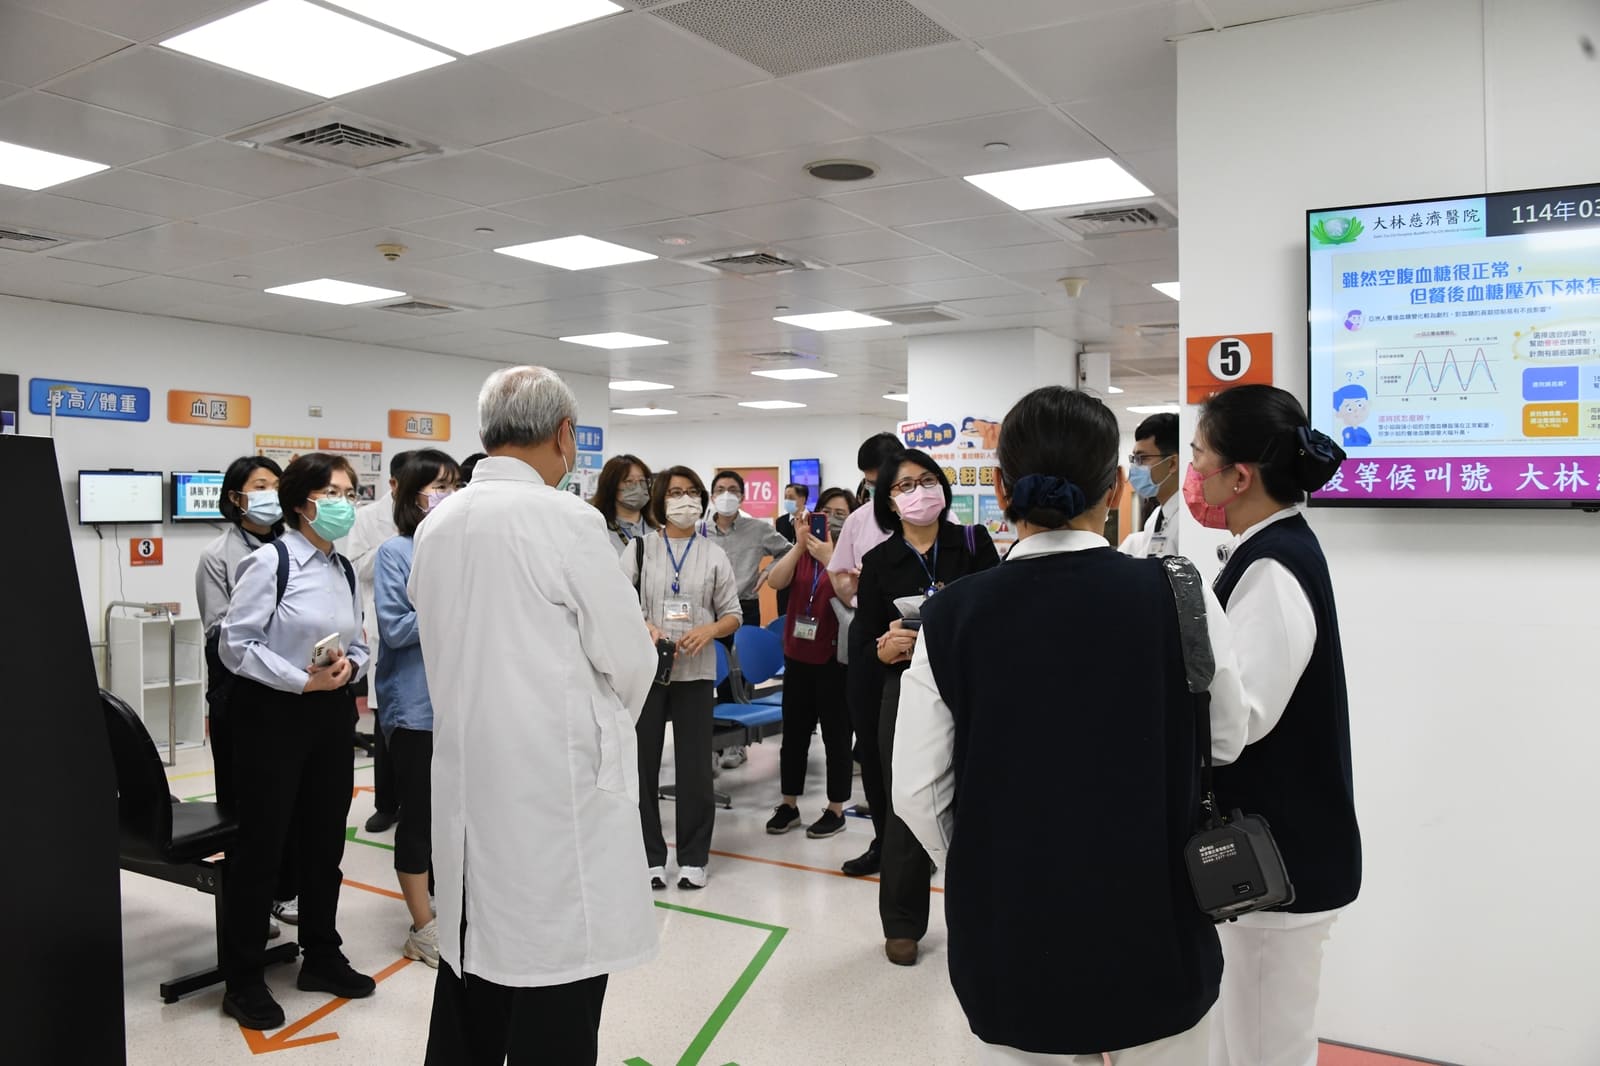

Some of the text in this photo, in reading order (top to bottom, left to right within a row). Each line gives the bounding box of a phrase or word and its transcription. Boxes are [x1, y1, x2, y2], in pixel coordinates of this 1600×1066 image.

[1372, 209, 1481, 231] 大林慈濟醫院
[1342, 261, 1523, 289] 雖然空腹血糖很正常，
[1220, 341, 1241, 376] 5
[47, 388, 136, 414] 身高/體重
[191, 399, 227, 420] 血壓
[406, 417, 432, 435] 血壓
[1515, 462, 1600, 492] 大林
[142, 540, 151, 555] 3
